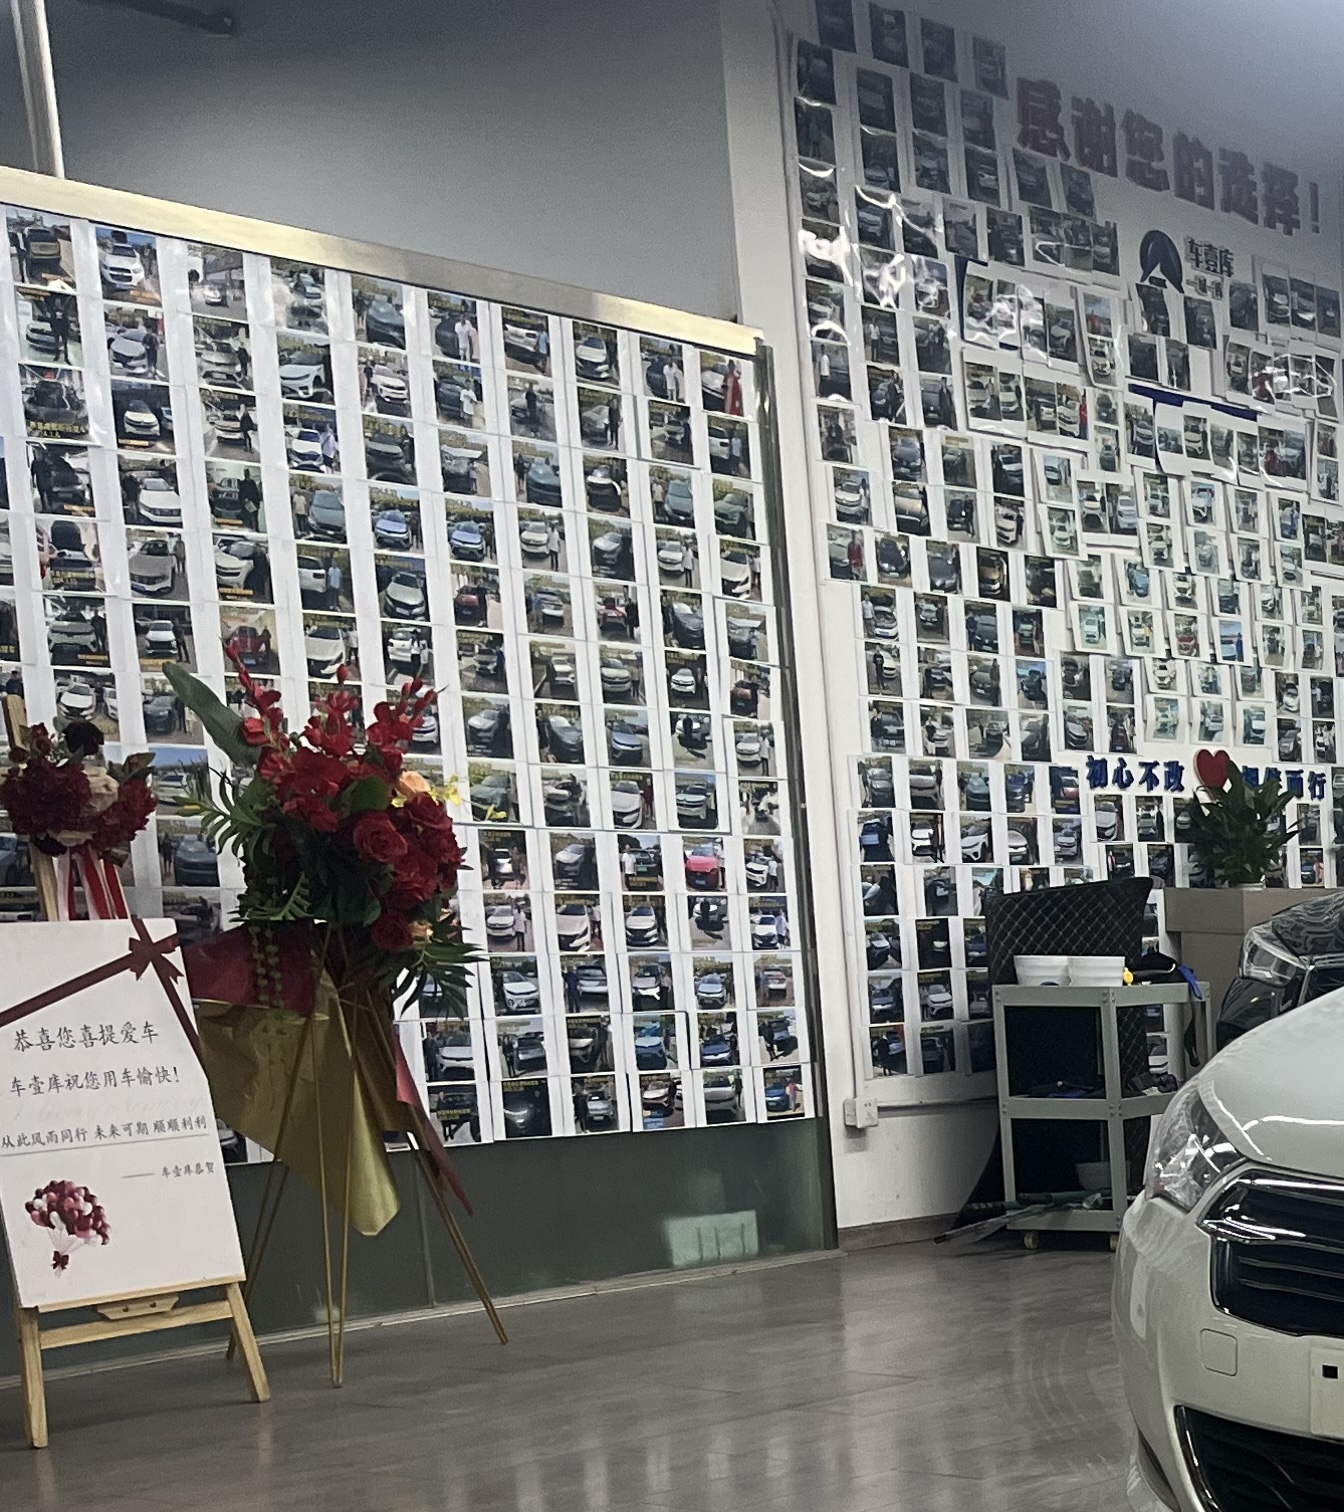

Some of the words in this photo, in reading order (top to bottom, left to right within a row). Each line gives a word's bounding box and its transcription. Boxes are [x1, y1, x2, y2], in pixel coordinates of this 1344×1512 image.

[1085, 754, 1186, 793] 初心不改
[13, 1020, 159, 1053] 恭喜您喜提爱车
[9, 1065, 181, 1098] 车壹库祝您用车愉快!
[0, 1126, 89, 1150] 从此风雨同行
[93, 1120, 149, 1141] 未来可期
[152, 1114, 208, 1134] 顺顺利利
